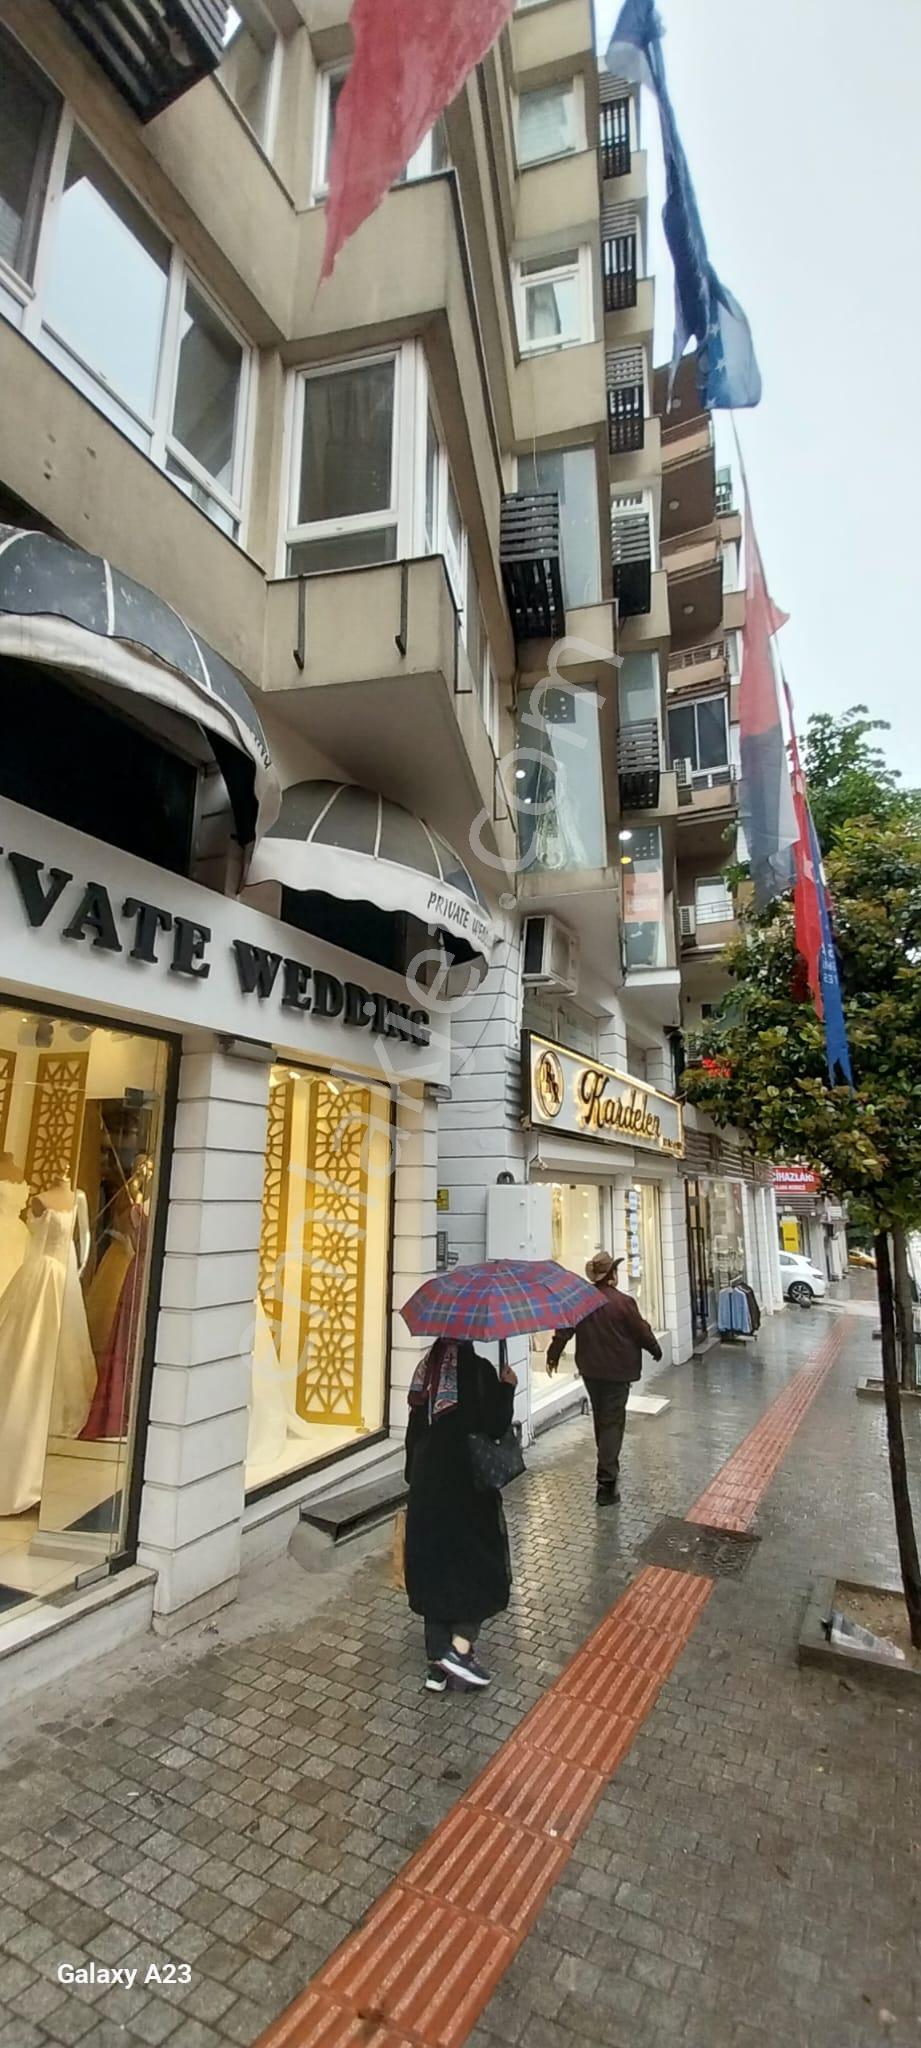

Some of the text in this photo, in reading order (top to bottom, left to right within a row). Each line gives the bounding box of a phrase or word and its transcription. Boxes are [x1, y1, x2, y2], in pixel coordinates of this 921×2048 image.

[427, 890, 471, 929] PRIVATE
[232, 939, 432, 1048] WEDDING
[580, 1069, 662, 1138] Kardelen
